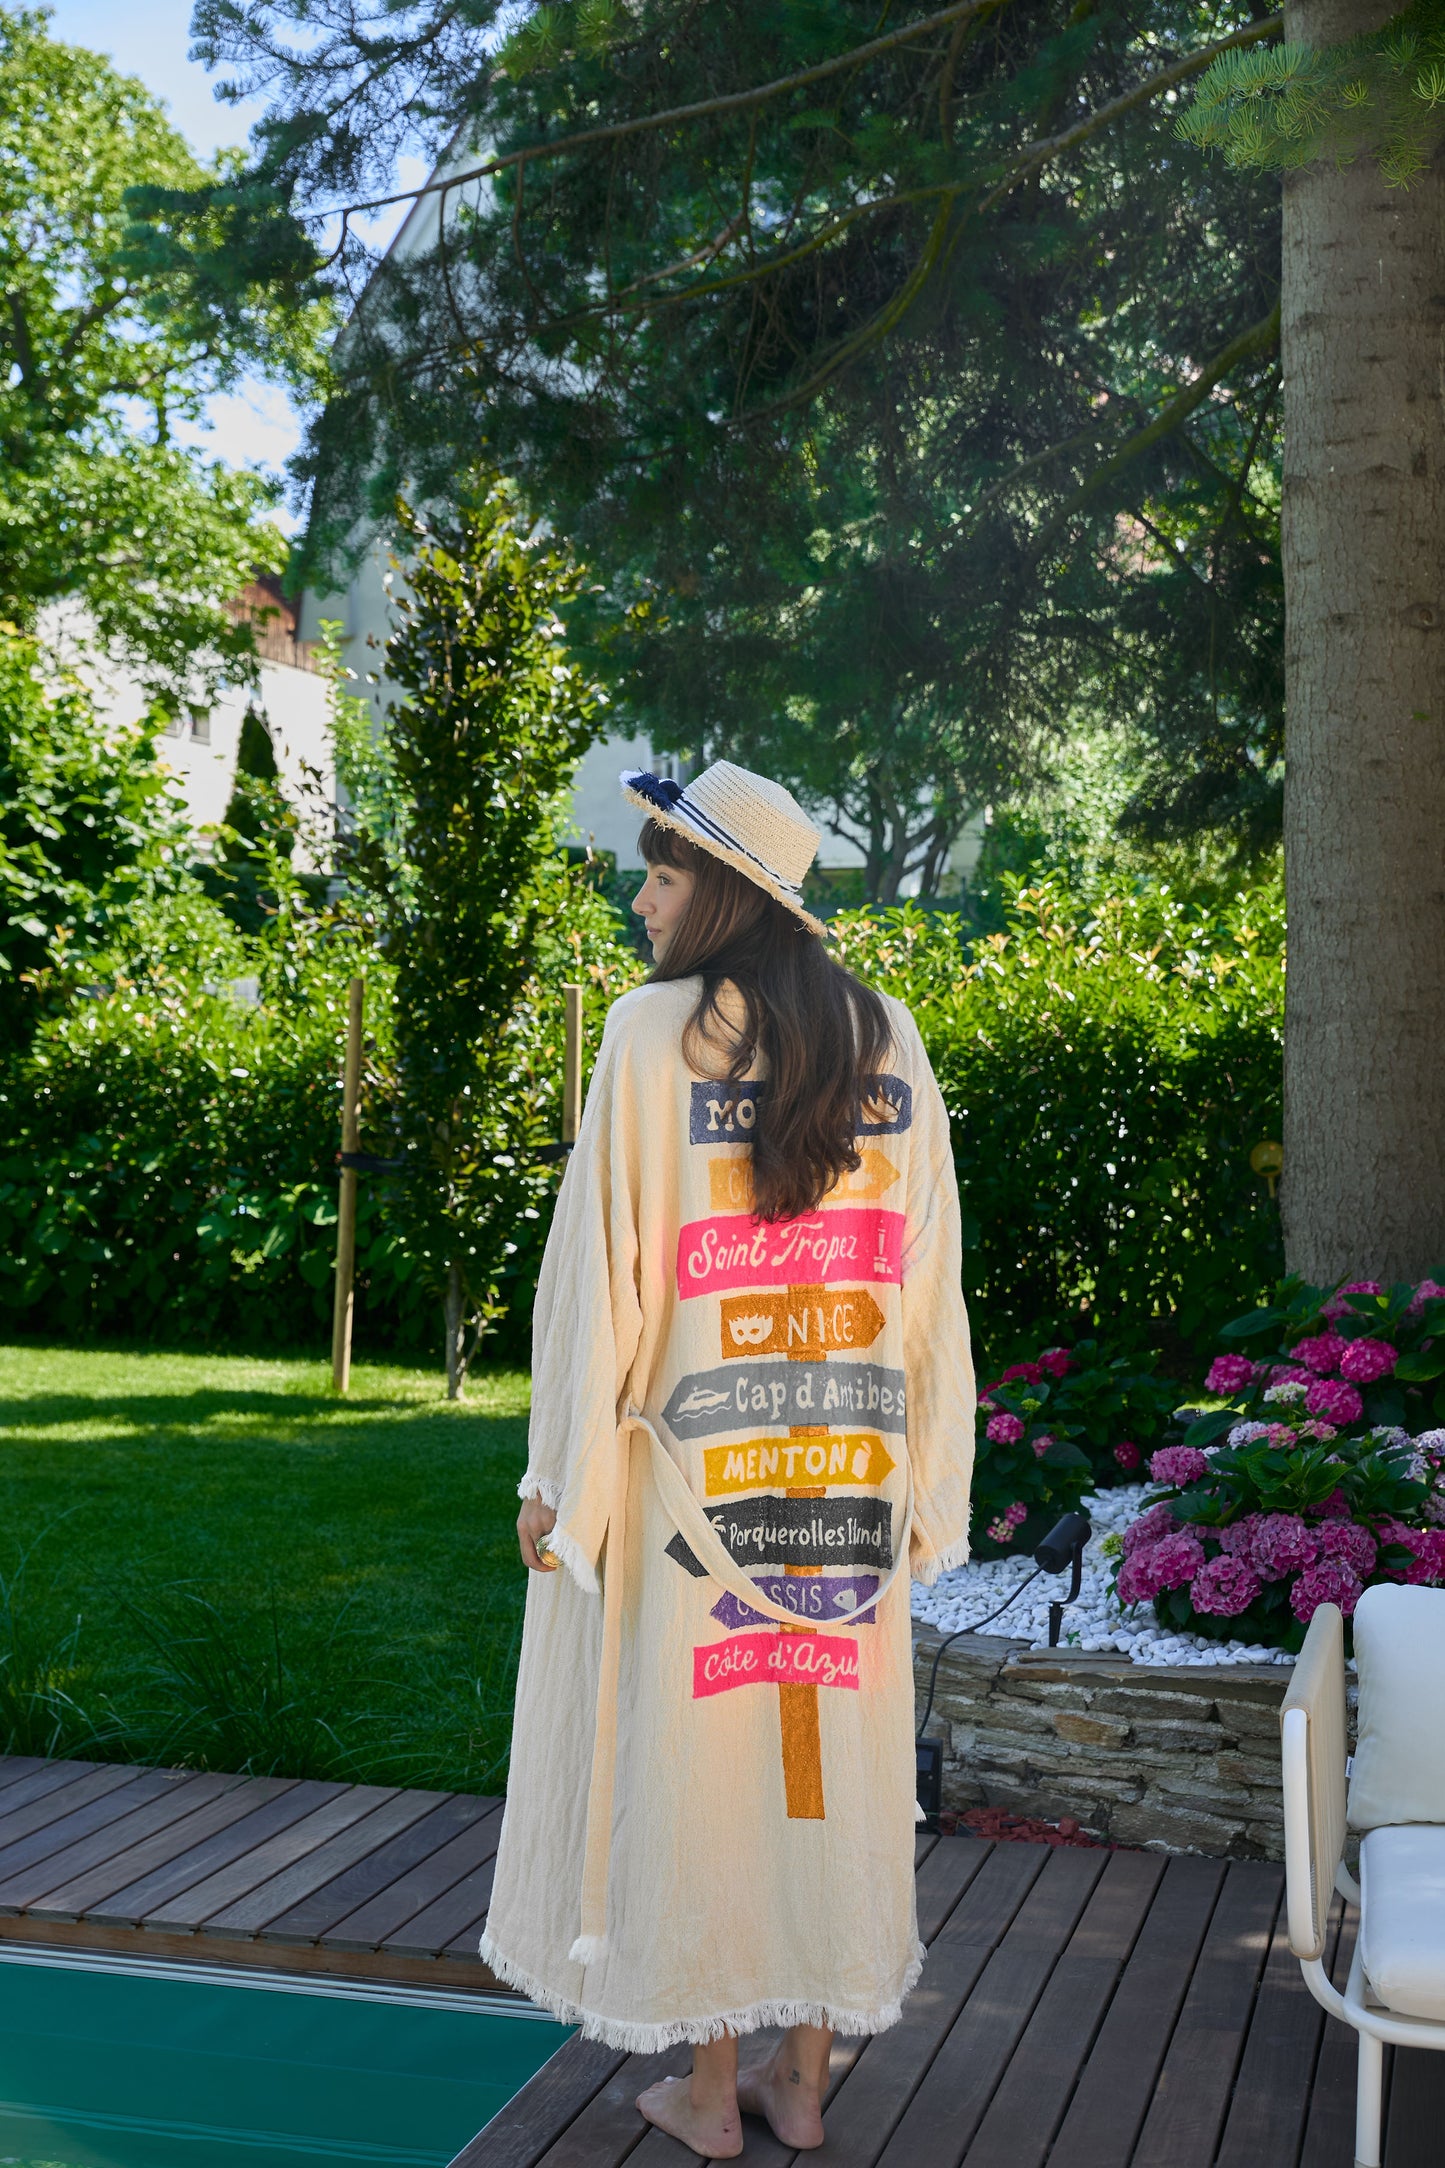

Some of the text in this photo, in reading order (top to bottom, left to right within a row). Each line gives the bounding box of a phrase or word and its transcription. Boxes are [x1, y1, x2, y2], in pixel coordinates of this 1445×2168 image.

[688, 1221, 858, 1279] Saint Tropez
[787, 1304, 854, 1347] NICE
[735, 1376, 787, 1420] Cap
[722, 1441, 847, 1483] MENTON
[730, 1518, 846, 1551] Porquerolles
[704, 1644, 759, 1681] Côte
